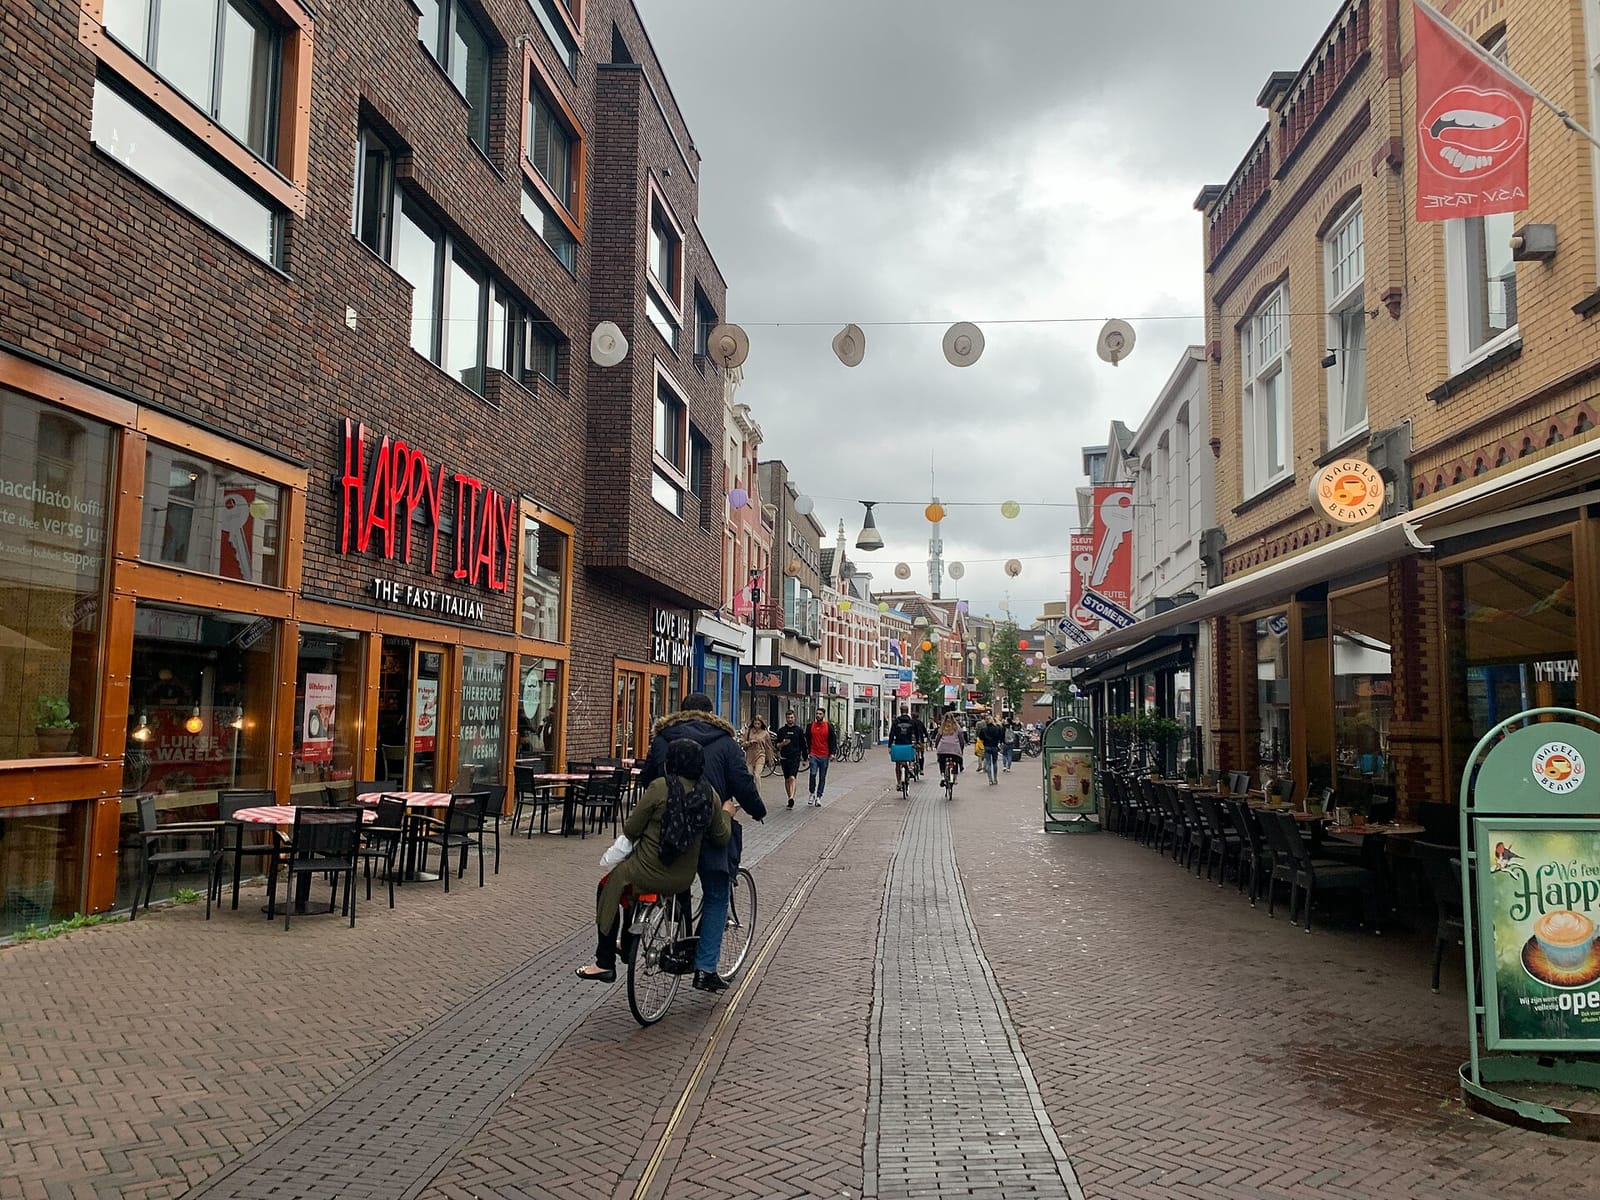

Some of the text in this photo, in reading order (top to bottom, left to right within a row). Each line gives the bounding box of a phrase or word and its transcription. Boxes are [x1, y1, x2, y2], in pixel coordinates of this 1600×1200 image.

[1324, 462, 1377, 483] BAGELS
[341, 416, 445, 575] HAPPY
[1328, 501, 1376, 519] BEANS
[0, 509, 16, 524] te
[43, 517, 83, 538] verse
[84, 522, 103, 546] ju
[453, 473, 515, 593] ITALY
[1072, 537, 1094, 545] SLEUT
[375, 578, 483, 621] THE FAST ITALIAN
[1100, 591, 1128, 599] EUTEL
[655, 608, 690, 640] LOVE LIFE
[655, 637, 694, 668] EAT HAPPY
[462, 686, 502, 701] THEREFORE
[467, 706, 499, 720] CANNOT
[460, 725, 500, 740] KEEP CALM
[160, 735, 219, 748] LUIKSE
[156, 748, 224, 761] WAFELS
[472, 744, 498, 760] PEESH?
[1536, 744, 1579, 761] BAGELS
[1541, 777, 1579, 791] BEANS
[1552, 860, 1577, 880] We
[1510, 866, 1600, 922] Happ
